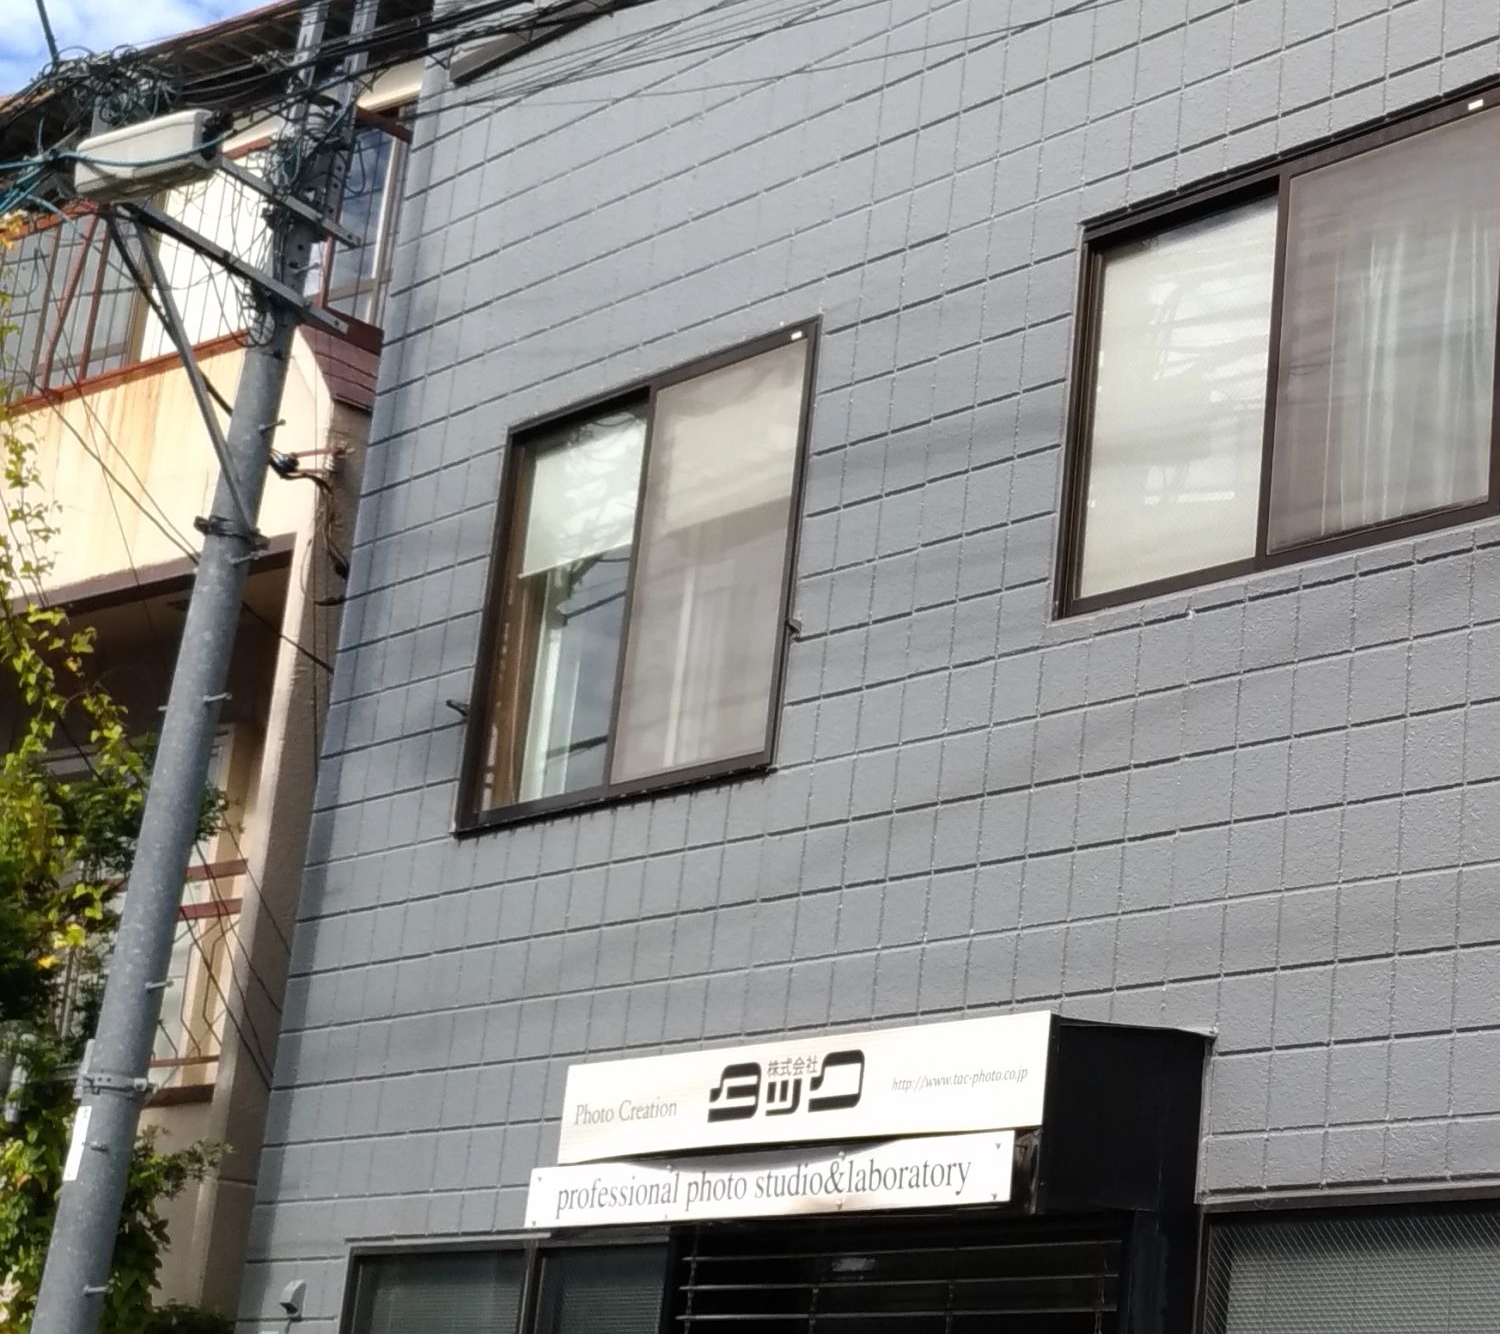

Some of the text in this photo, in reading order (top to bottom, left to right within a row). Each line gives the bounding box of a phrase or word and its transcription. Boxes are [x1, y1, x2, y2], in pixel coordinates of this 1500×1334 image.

[707, 1049, 865, 1123] タック
[767, 1055, 818, 1078] 株式会社
[574, 1096, 677, 1125] Photo Creation
[555, 1158, 972, 1219] professional photo studio&laboratory
